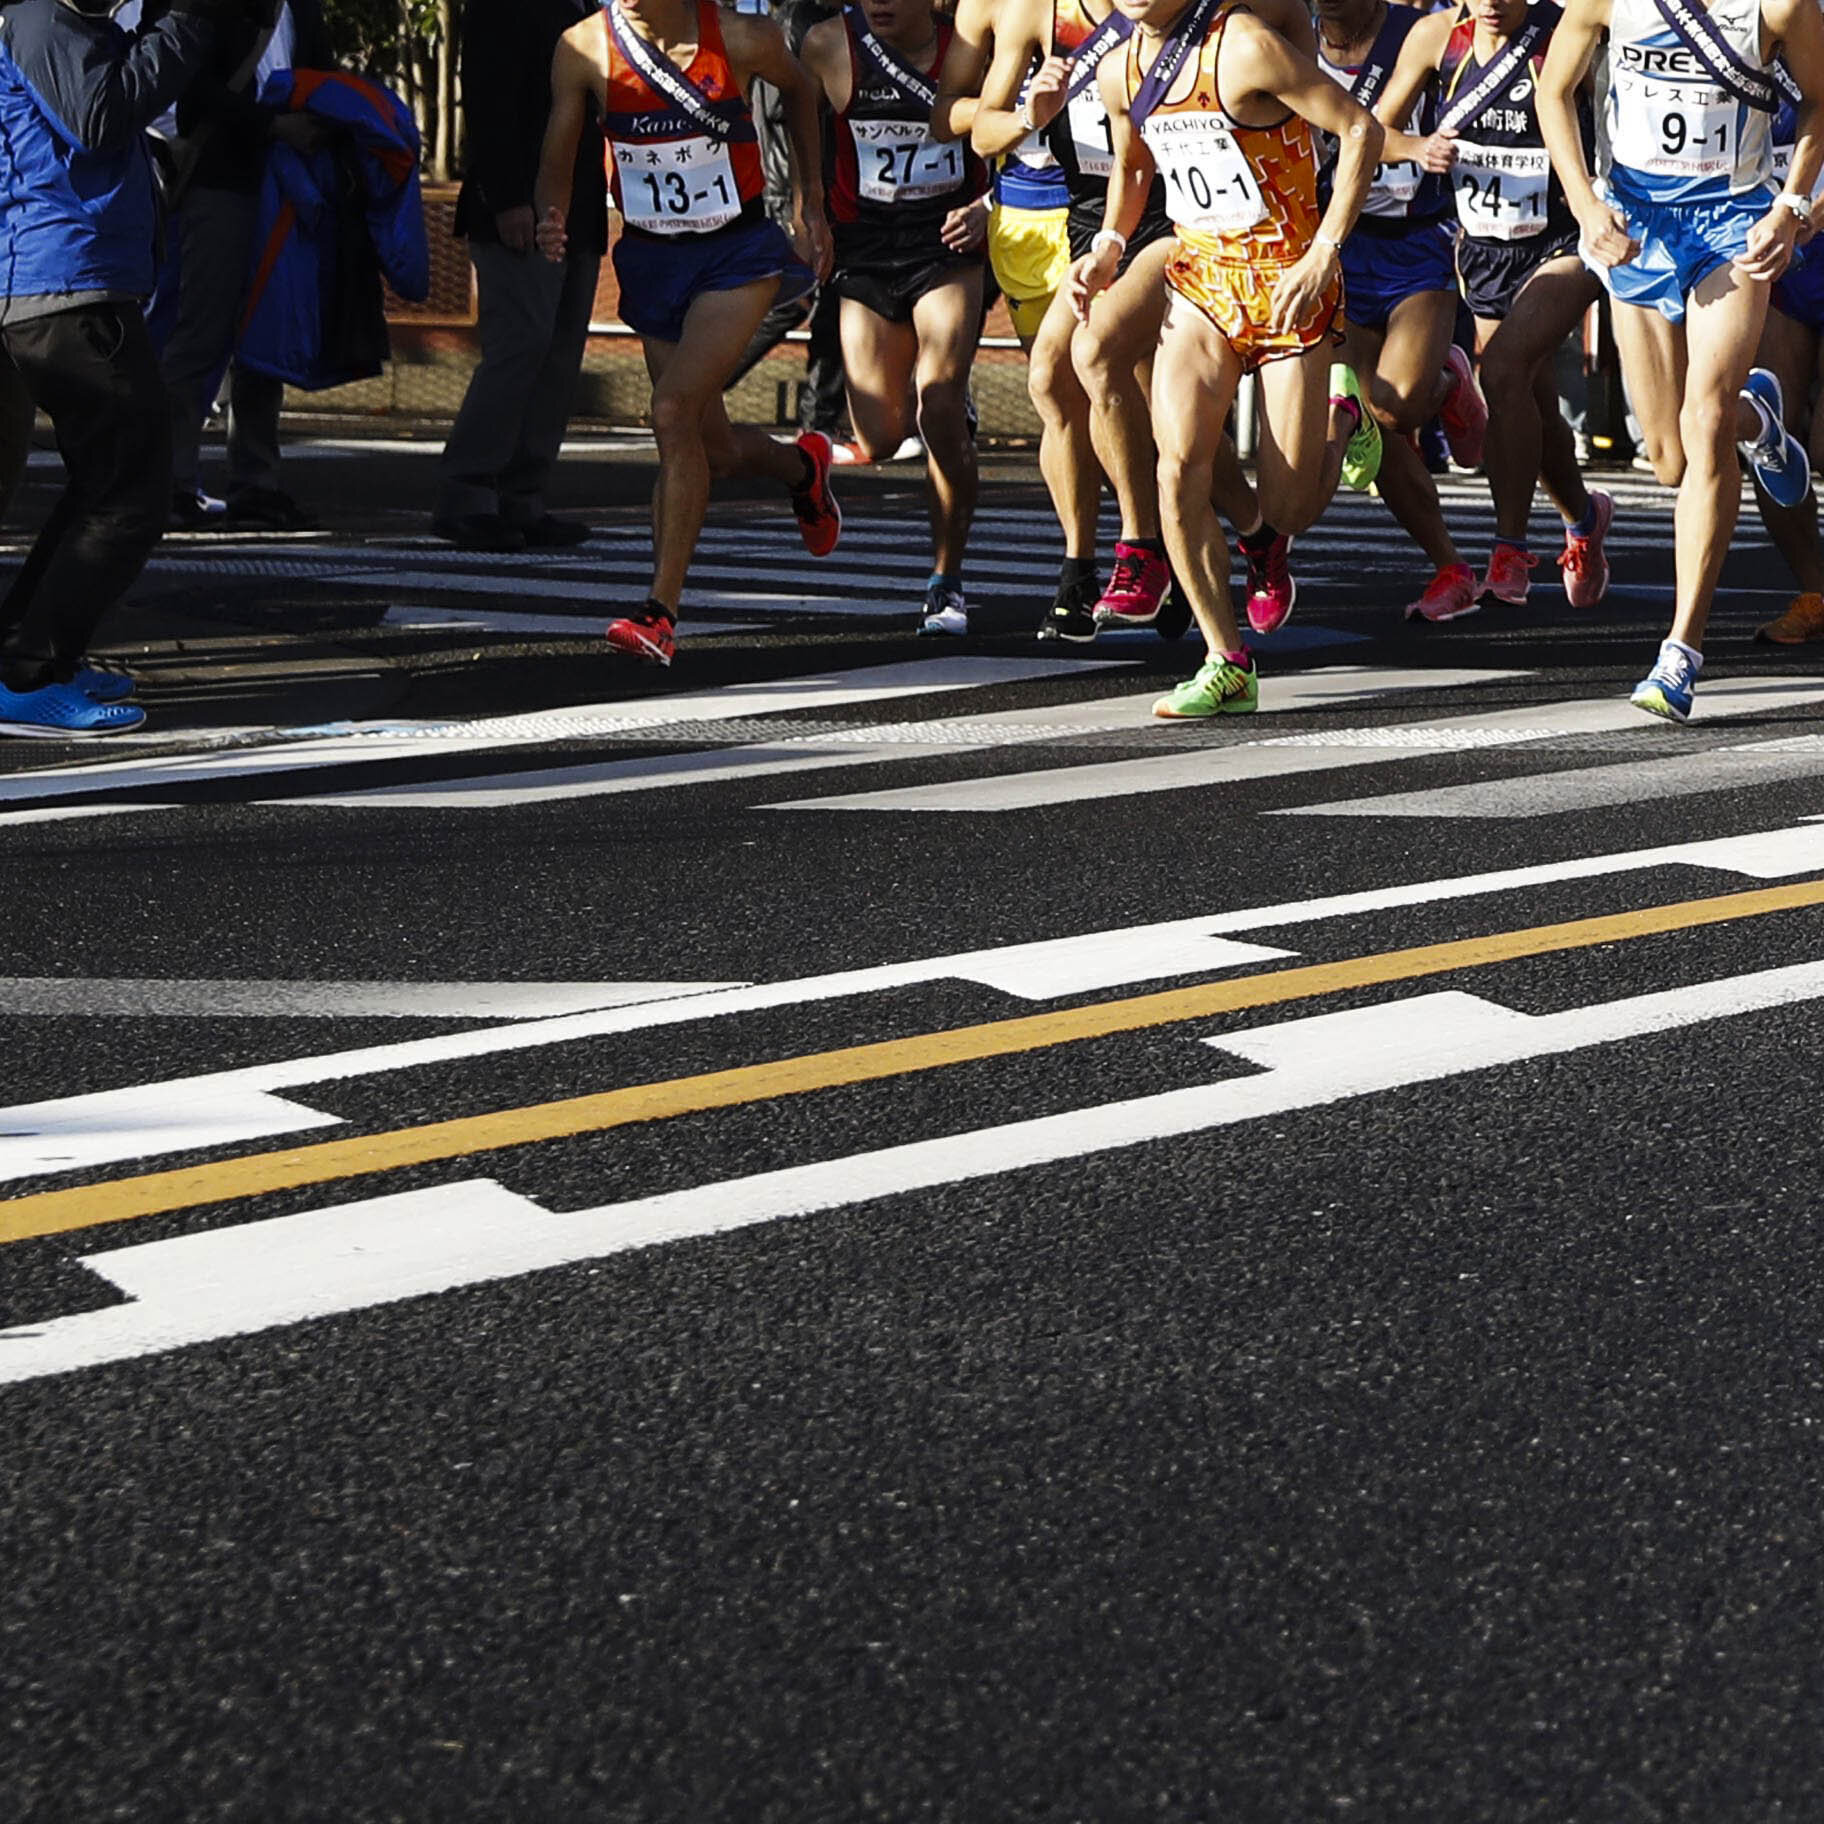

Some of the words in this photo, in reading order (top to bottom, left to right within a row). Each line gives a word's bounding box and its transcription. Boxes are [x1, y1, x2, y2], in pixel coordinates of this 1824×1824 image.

[617, 139, 724, 166] カネボウ
[1661, 112, 1728, 156] 9-1
[876, 144, 957, 185] 27-1
[643, 172, 730, 215] 13-1
[1170, 166, 1250, 209] 10-1
[1462, 174, 1541, 217] 24-1
